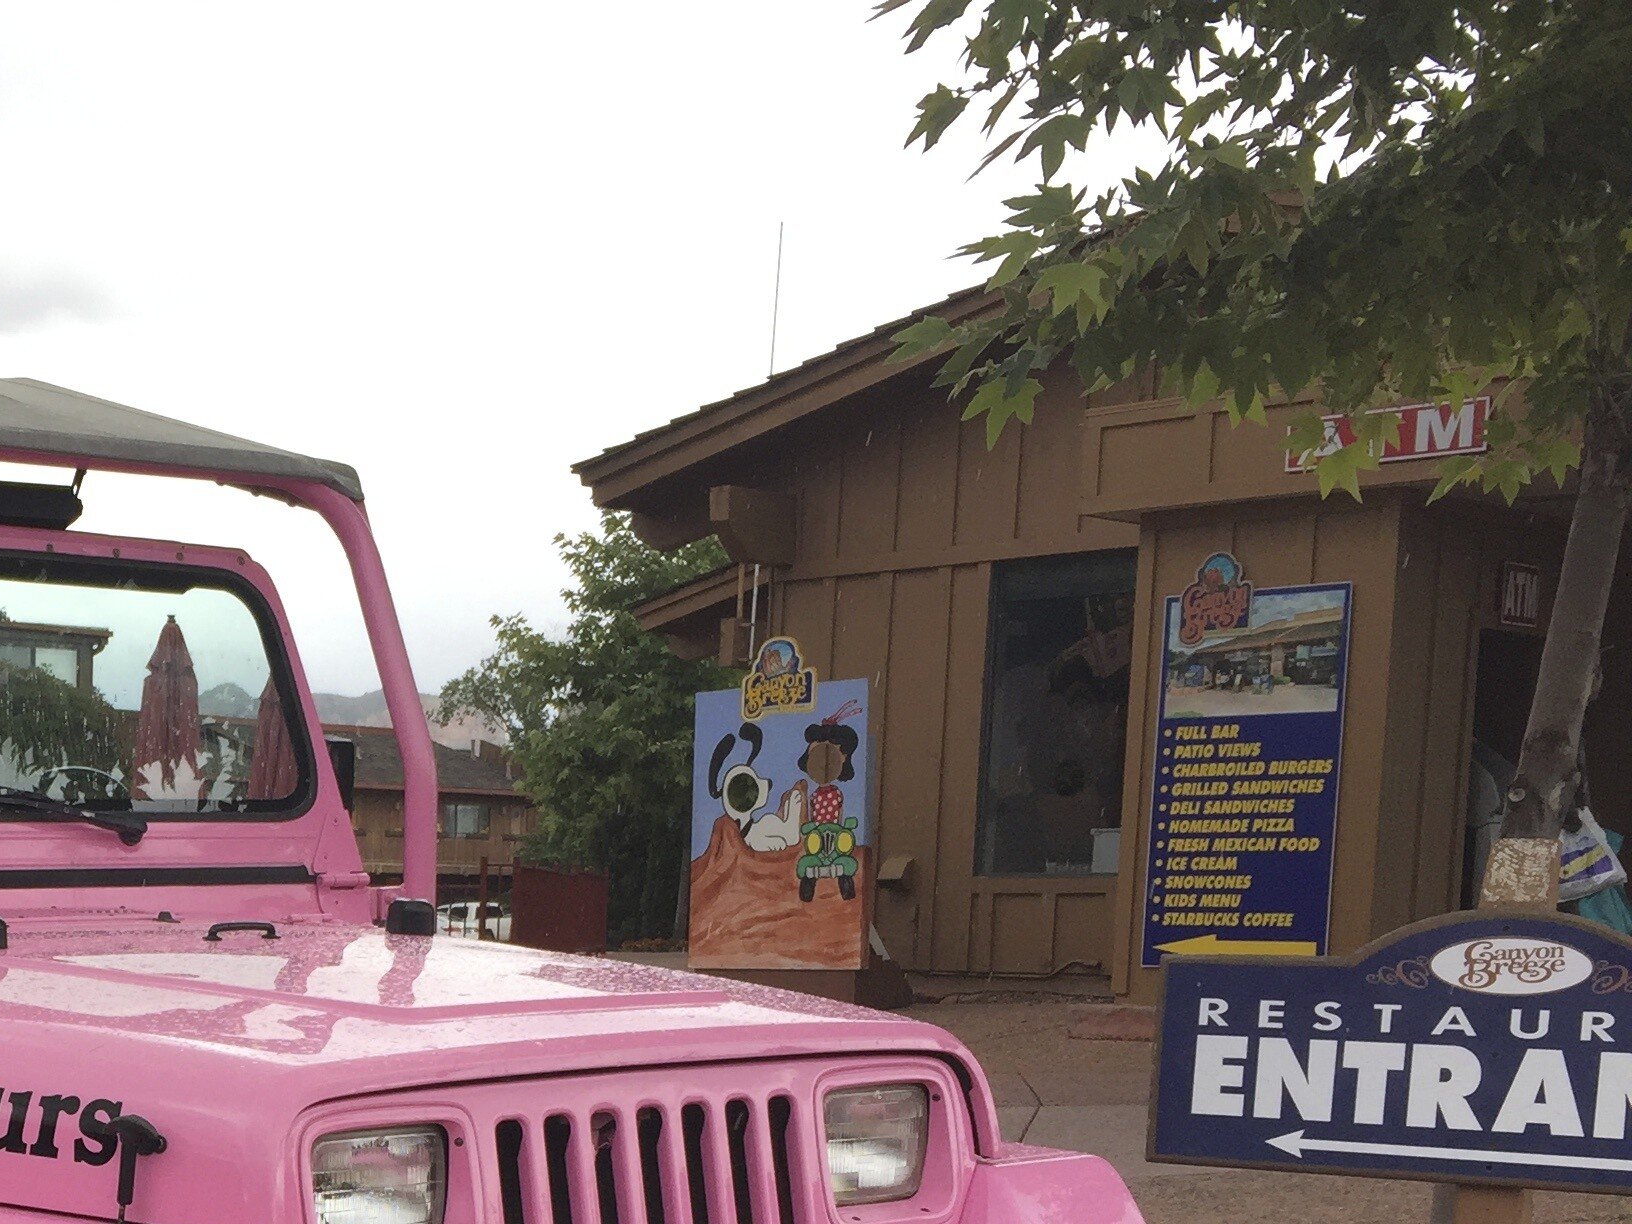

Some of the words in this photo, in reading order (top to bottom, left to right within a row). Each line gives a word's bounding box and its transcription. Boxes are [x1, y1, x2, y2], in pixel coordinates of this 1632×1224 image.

[1297, 402, 1475, 467] AM
[1504, 571, 1537, 618] ATM
[747, 672, 806, 695] Canyon
[1175, 725, 1207, 740] FULL
[1211, 724, 1240, 739] BAR
[1174, 744, 1214, 759] PATIO
[1218, 742, 1261, 757] VIEWS
[1172, 761, 1266, 777] CHARBROILED
[1268, 759, 1334, 775] BURGERS
[1171, 781, 1229, 796] GRILLED
[1231, 779, 1325, 796] SANDWICHES
[1170, 801, 1201, 815] DELI
[1203, 799, 1295, 814] SANDWICHES
[1168, 819, 1250, 834] HOMEMADE
[1252, 818, 1295, 833] PIZZA
[1167, 838, 1210, 852] FRESH
[1212, 838, 1276, 852] MEXICAN
[1279, 837, 1321, 852] FOOD
[1166, 856, 1188, 871] ICE
[1190, 856, 1238, 871] CREAM
[1164, 875, 1252, 890] SNOWCONES
[1163, 894, 1197, 908] KIDS
[1199, 894, 1242, 908] MENU
[1162, 912, 1240, 927] STARBUCKS
[1243, 913, 1295, 927] COFFEE
[1464, 941, 1565, 967] Canyon
[1458, 959, 1566, 988] Breeze
[1198, 998, 1616, 1043] RESTAUR
